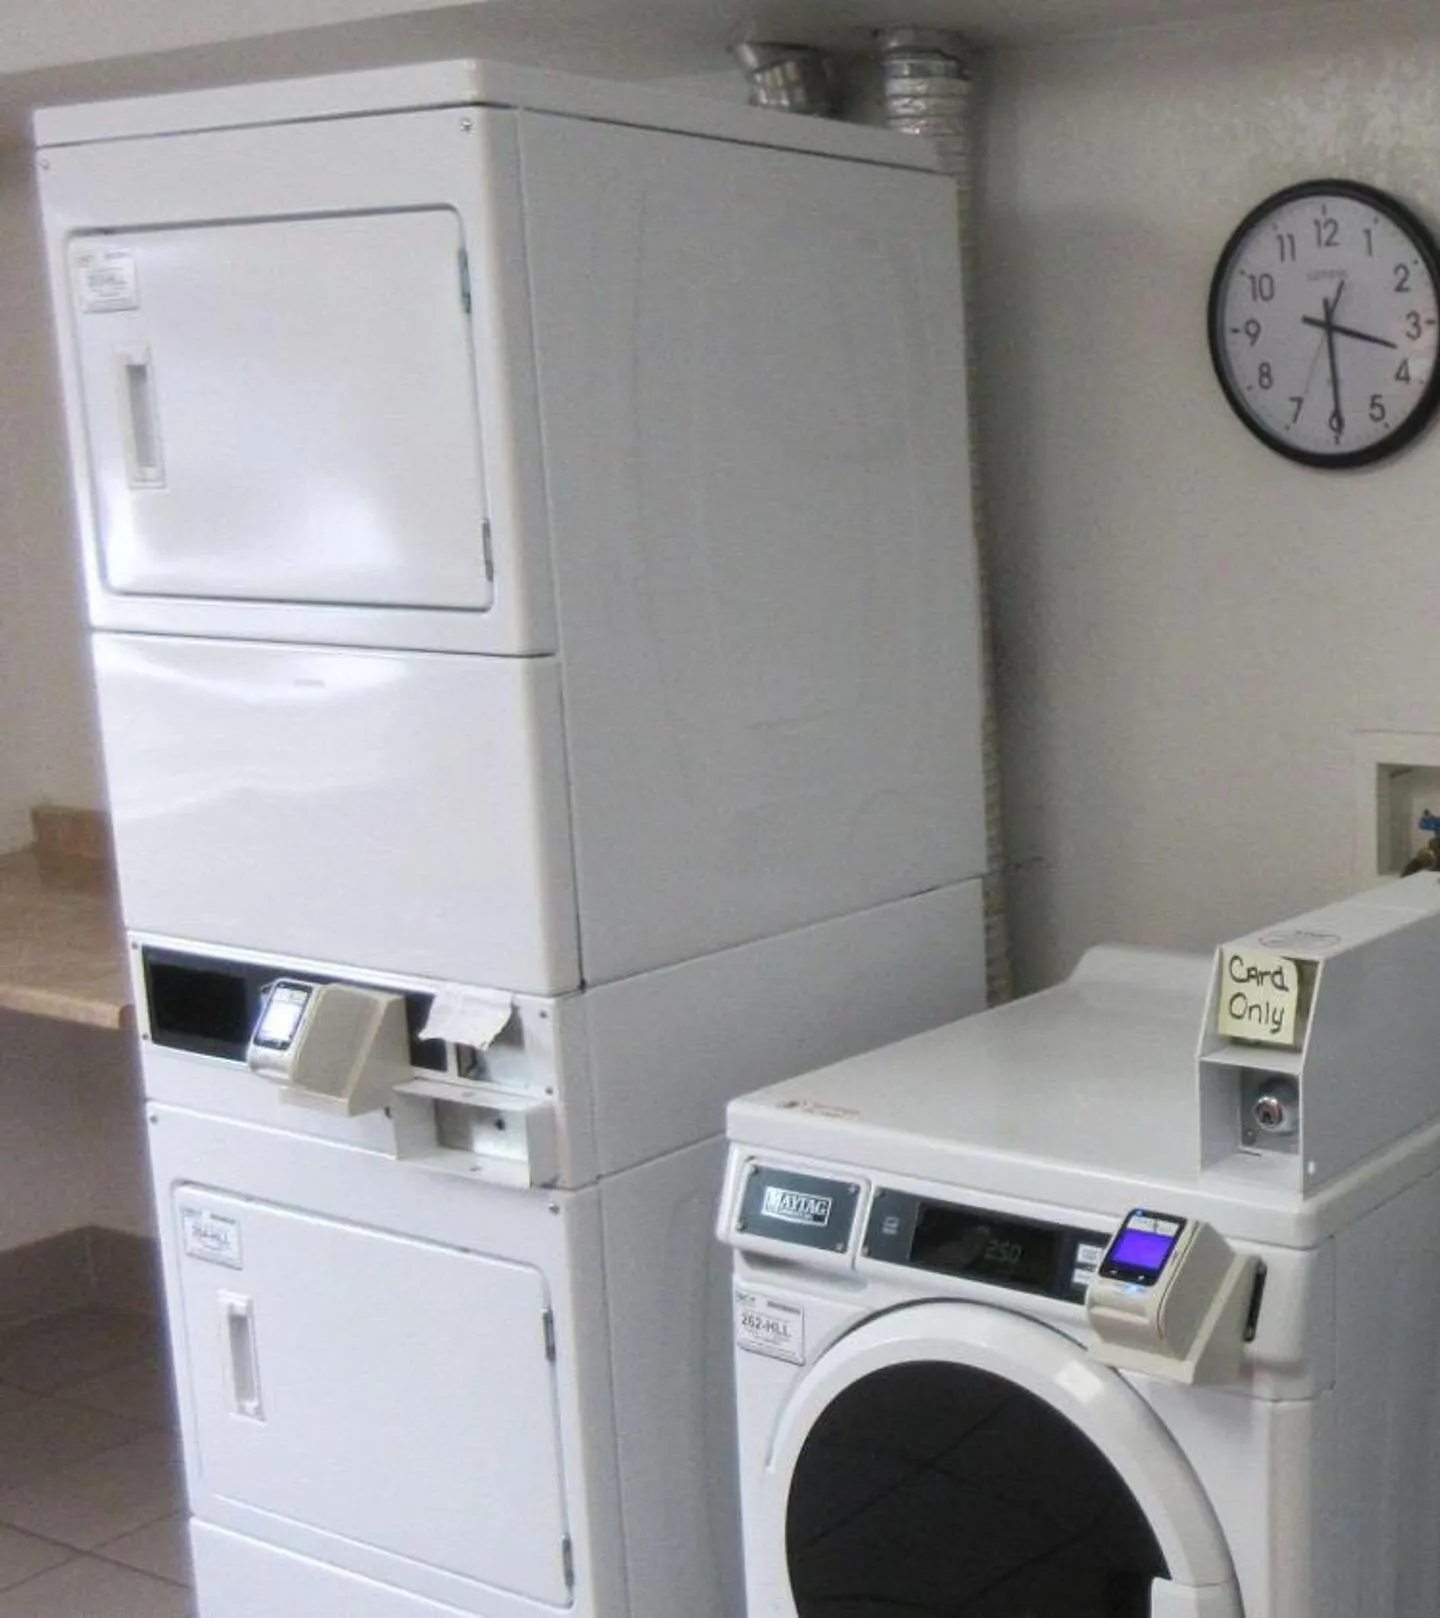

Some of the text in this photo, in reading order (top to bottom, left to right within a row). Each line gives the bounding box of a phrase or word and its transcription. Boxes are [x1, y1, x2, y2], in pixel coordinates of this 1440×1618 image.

[1313, 218, 1340, 248] 12
[1364, 228, 1373, 257] 1
[1276, 233, 1297, 263] 11
[1249, 273, 1275, 302] 10
[1394, 264, 1410, 292] 2
[1245, 319, 1262, 348] 9
[1405, 311, 1422, 340] 3
[1258, 362, 1274, 390] 8
[1395, 358, 1411, 386] 4
[1289, 396, 1304, 424] 7
[1368, 394, 1387, 422] 5
[1229, 992, 1285, 1034] Only
[767, 1191, 827, 1216] MAYTAG
